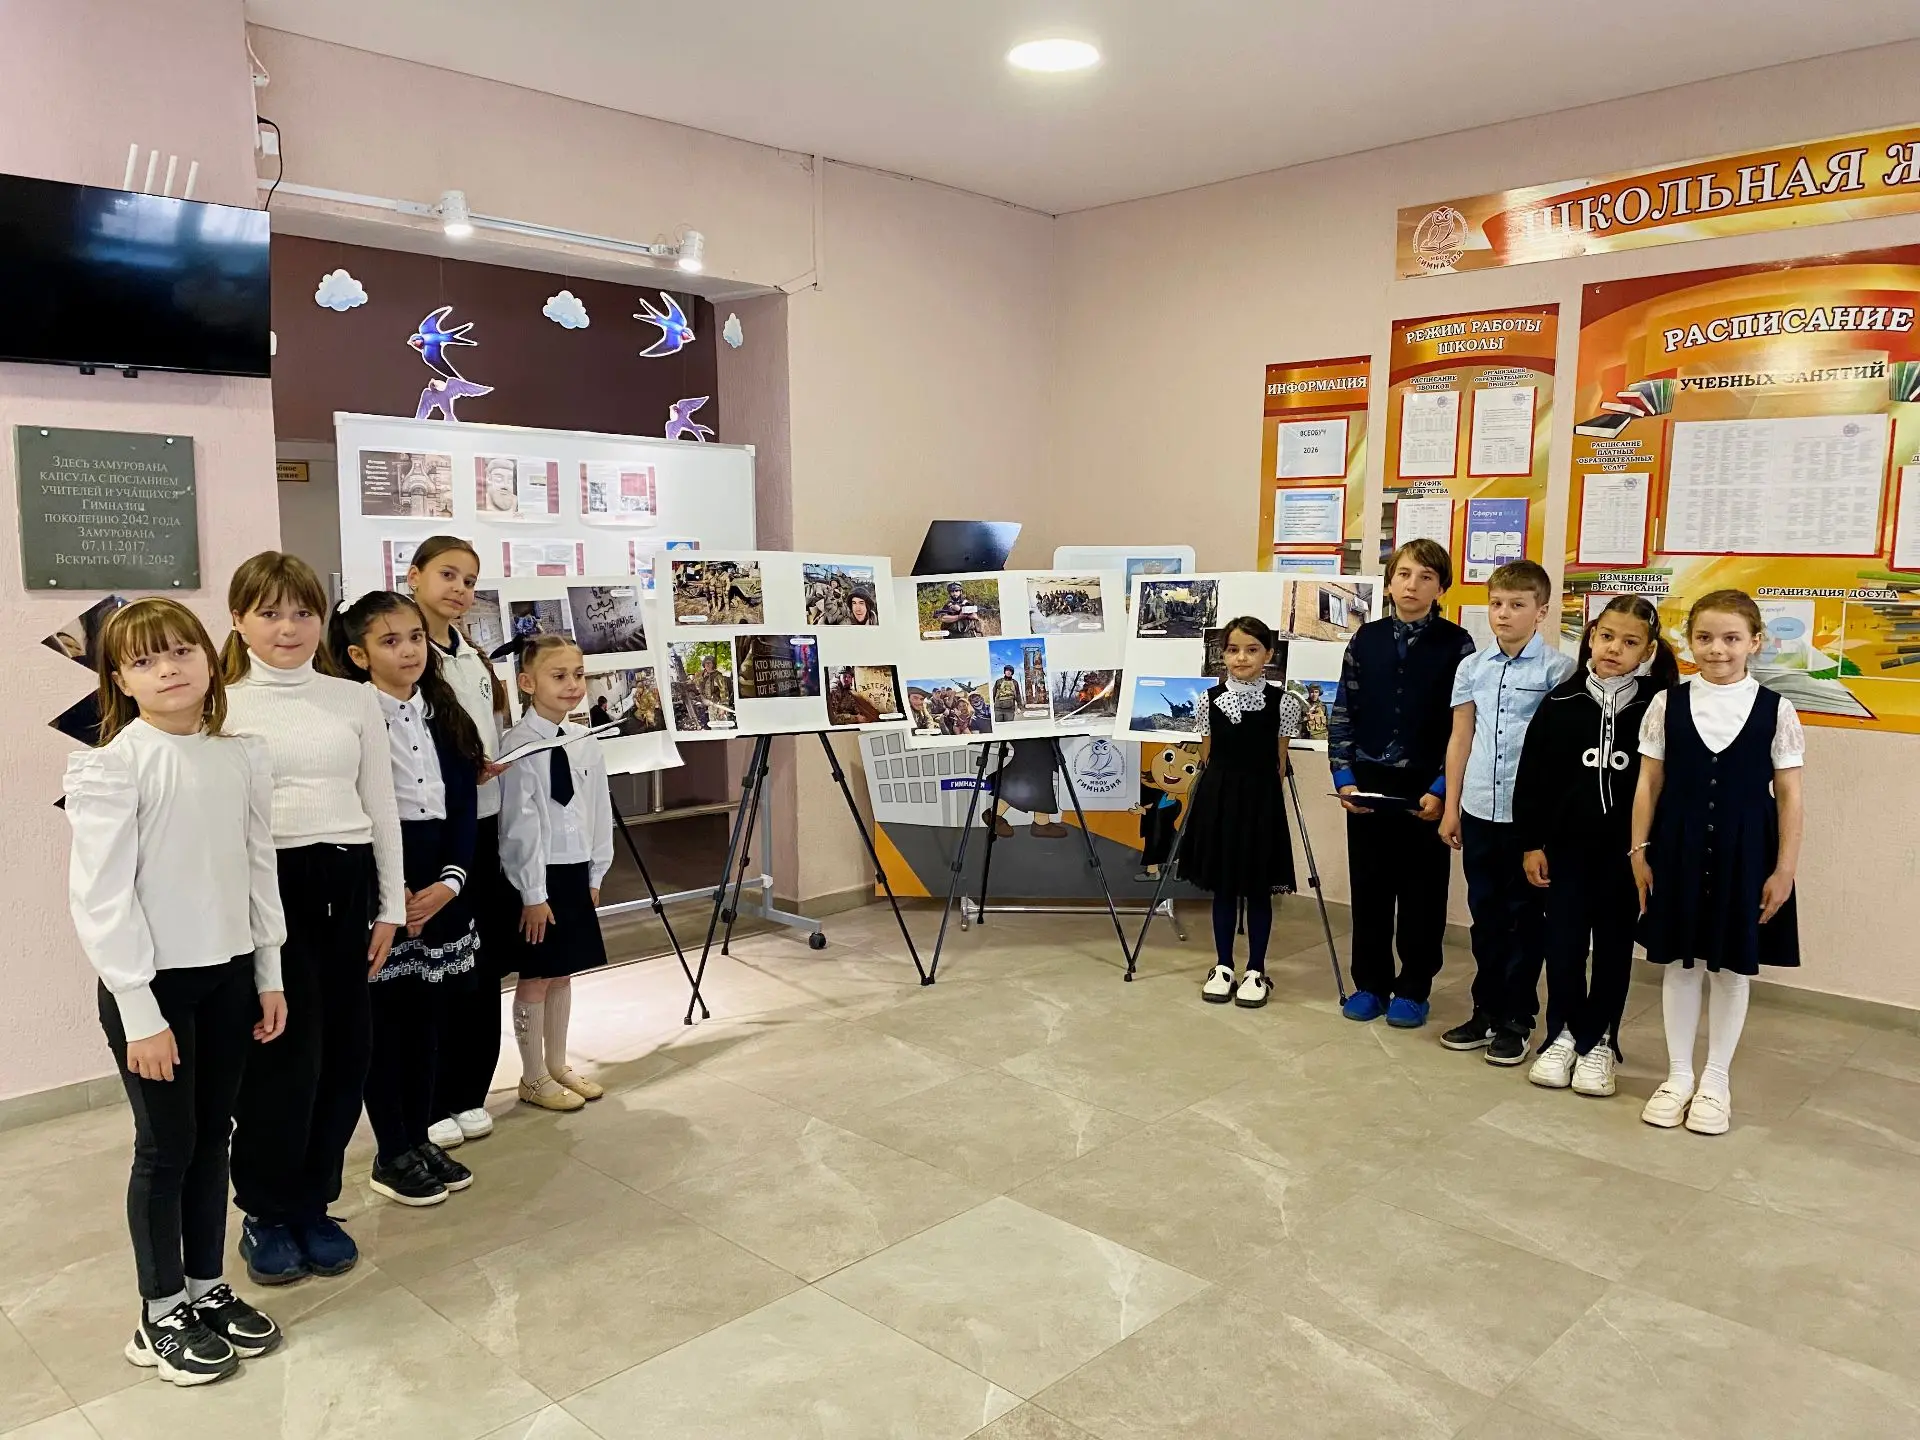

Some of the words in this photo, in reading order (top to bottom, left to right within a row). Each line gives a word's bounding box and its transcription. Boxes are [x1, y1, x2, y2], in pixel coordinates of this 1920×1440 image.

[1525, 147, 1868, 237] ШКОЛЬНАЯ
[1416, 250, 1464, 270] ГИМНАЗИЯ
[1405, 322, 1467, 344] РЕЖИМ
[1470, 319, 1542, 333] РАБОТЫ
[1664, 306, 1915, 352] РАСПИСАНИЕ
[1438, 337, 1505, 355] ШКОЛЫ
[1680, 373, 1776, 391] УЧЕБНЫХ
[1782, 361, 1886, 385] ЗАНЯТИЙ
[1267, 376, 1368, 395] ИНФОРМАЦИЯ
[1299, 428, 1327, 437] ВСЕОБУЧ
[1597, 448, 1635, 456] ПЛАТНЫХ
[52, 455, 90, 469] ЗДЕСЬ
[91, 459, 168, 473] ЗАМУРОВАНА
[1578, 455, 1653, 464] ОБРАЗОВАТЕЛЬНЫХ
[39, 471, 96, 483] КАПСУЛА
[98, 473, 106, 483] С
[109, 474, 179, 486] ПОСЛАНИЕМ
[41, 485, 102, 497] УЧИТЕЛЕЙ
[105, 487, 113, 497] И
[116, 488, 179, 500] УЧАЩИХСЯ
[82, 499, 146, 511] ГИМНАЗИИ
[44, 513, 119, 525] ПОКОЛЕНИЮ
[121, 514, 150, 525] 2042
[152, 516, 181, 527] ГОДА
[78, 526, 155, 539] ЗАМУРОВАНА
[55, 553, 111, 565] ВСКРЫТЬ
[112, 554, 176, 566] 07.11.2042
[1599, 573, 1663, 582] ИЗМЕНЕНИЯ
[1591, 583, 1599, 591] В
[1601, 583, 1670, 593] РАСПИСАНИИ
[1757, 587, 1845, 598] ОРГАНИЗАЦИЯ
[1847, 588, 1899, 599] ДОСУГА
[950, 780, 986, 789] ГИМНАЗЯ
[1076, 778, 1122, 793] ГИМНАЗИЯ
